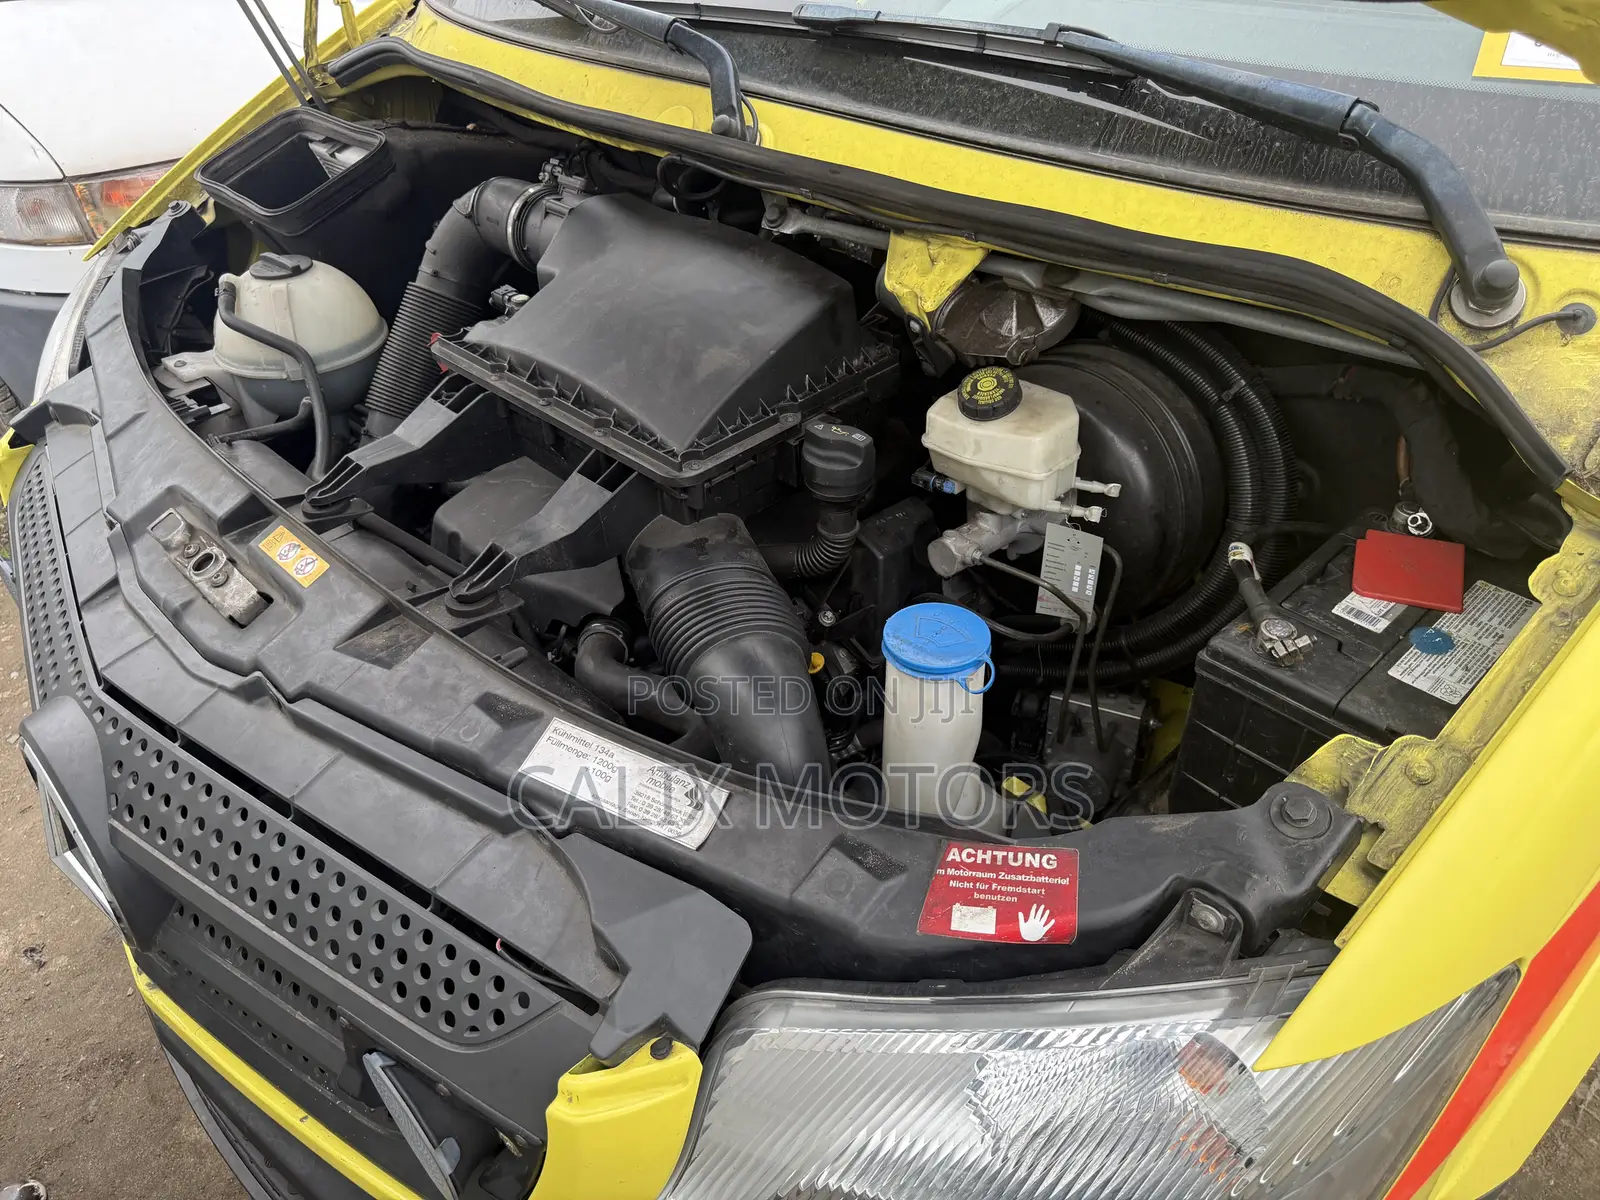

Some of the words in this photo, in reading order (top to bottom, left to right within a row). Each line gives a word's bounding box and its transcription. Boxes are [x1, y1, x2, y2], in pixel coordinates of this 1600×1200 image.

[552, 726, 594, 749] Kühlmittel
[595, 744, 615, 759] 134a
[545, 736, 591, 761] Füllmenge:
[592, 756, 619, 774] 1200g
[591, 767, 613, 783] 100g
[646, 765, 692, 790] Ambulanz
[646, 777, 676, 794] mobile
[946, 847, 1058, 869] ACHTUNG
[946, 867, 996, 879] Motorraum
[998, 871, 1070, 885] Zusatzbatterie!
[949, 880, 974, 889] Nicht
[975, 882, 989, 890] für
[991, 883, 1046, 895] Fremdstart
[974, 891, 1018, 902] benutzen
